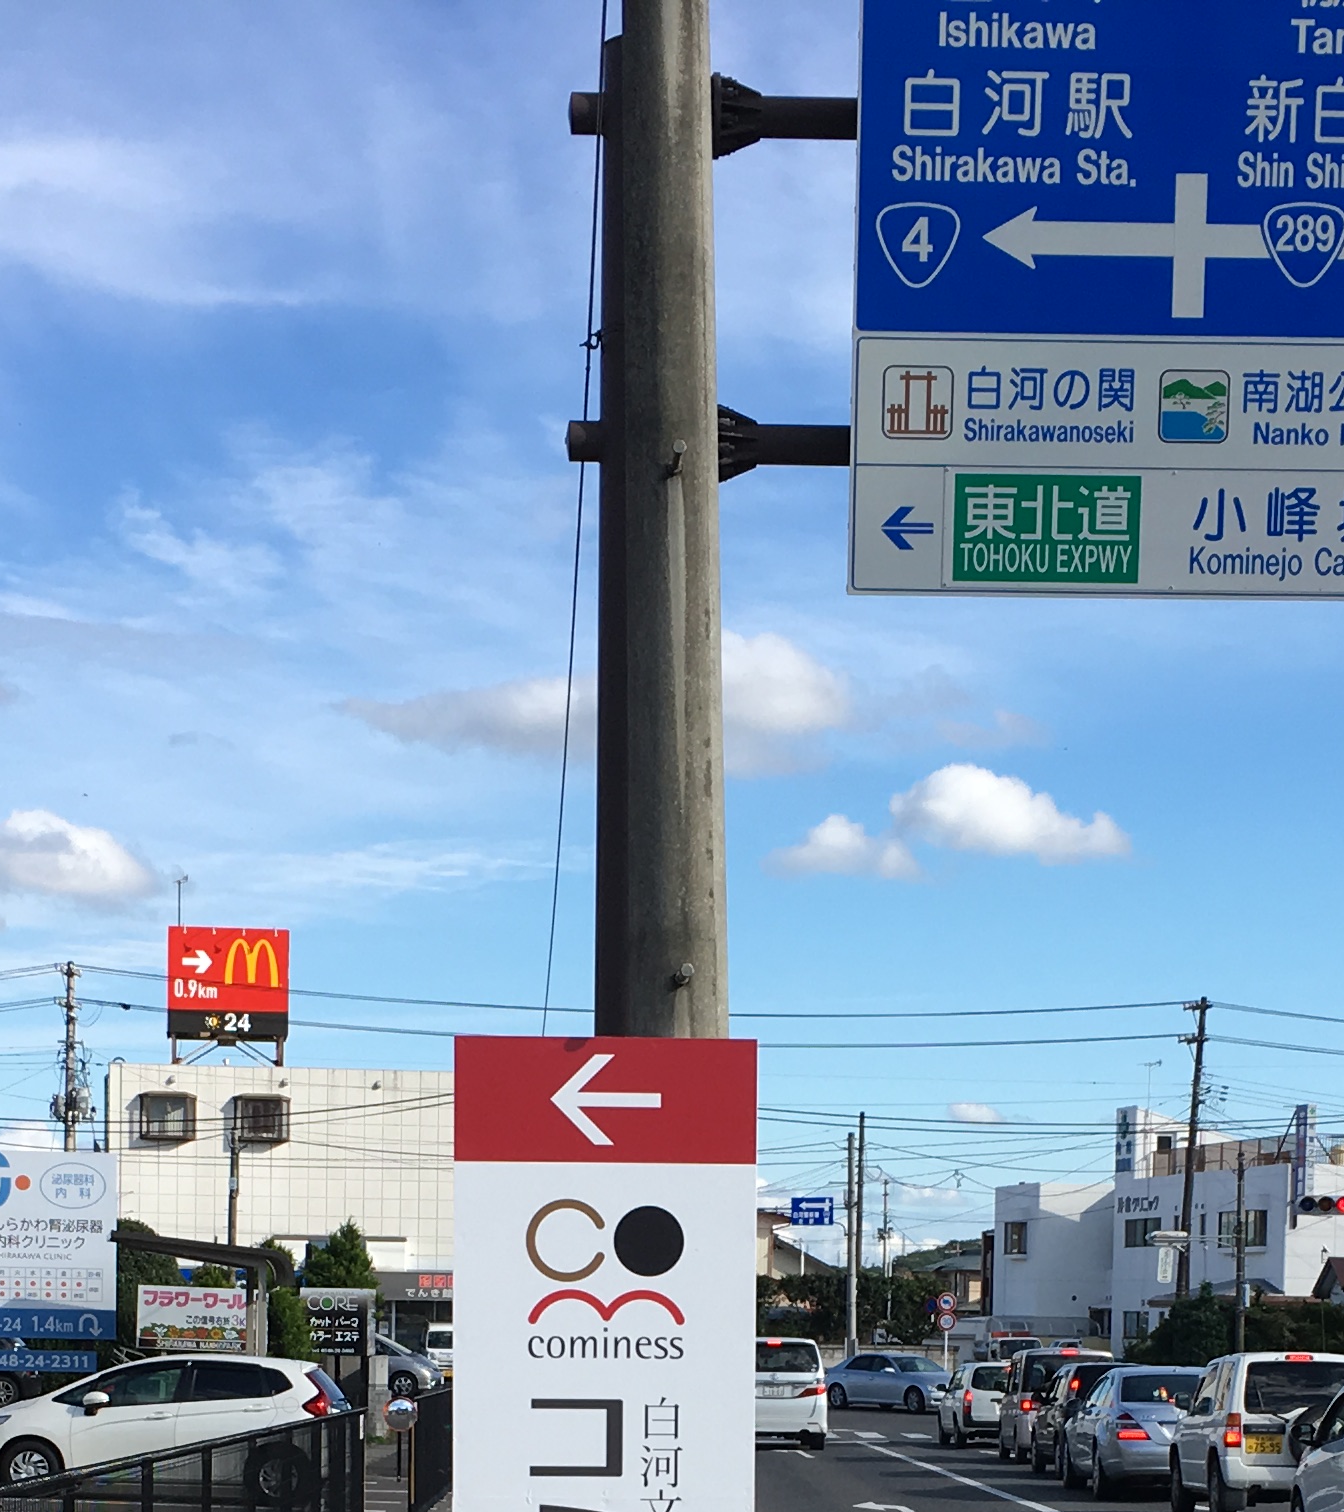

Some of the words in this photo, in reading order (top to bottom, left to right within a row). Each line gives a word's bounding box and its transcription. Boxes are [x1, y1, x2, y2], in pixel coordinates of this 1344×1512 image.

[938, 10, 1097, 51] Ishikawa
[902, 69, 1133, 140] 白河駅
[891, 144, 1061, 185] Shirakawa
[1076, 148, 1137, 188] Sta.
[1237, 151, 1294, 188] Shin
[902, 216, 934, 263] 4
[1275, 214, 1336, 252] 289
[966, 365, 1135, 412] 白河の関
[963, 417, 1134, 443] Shirakawanoseki
[1252, 421, 1330, 446] Nanko
[963, 484, 1132, 542] 東北道
[959, 542, 1049, 573] TOHOKU
[1056, 544, 1133, 574] EXPWY
[1189, 545, 1303, 582] Kominejo
[173, 978, 218, 999] 0.9km
[223, 1013, 252, 1032] 24
[43, 1252, 73, 1261] CLINIC
[143, 1289, 247, 1310] フラワーワール
[307, 1295, 359, 1312] CORE
[31, 1315, 74, 1333] 1.4km
[309, 1315, 332, 1327] カット
[309, 1330, 332, 1341] カラー
[335, 1331, 360, 1342] エステ
[527, 1327, 684, 1360] cominess
